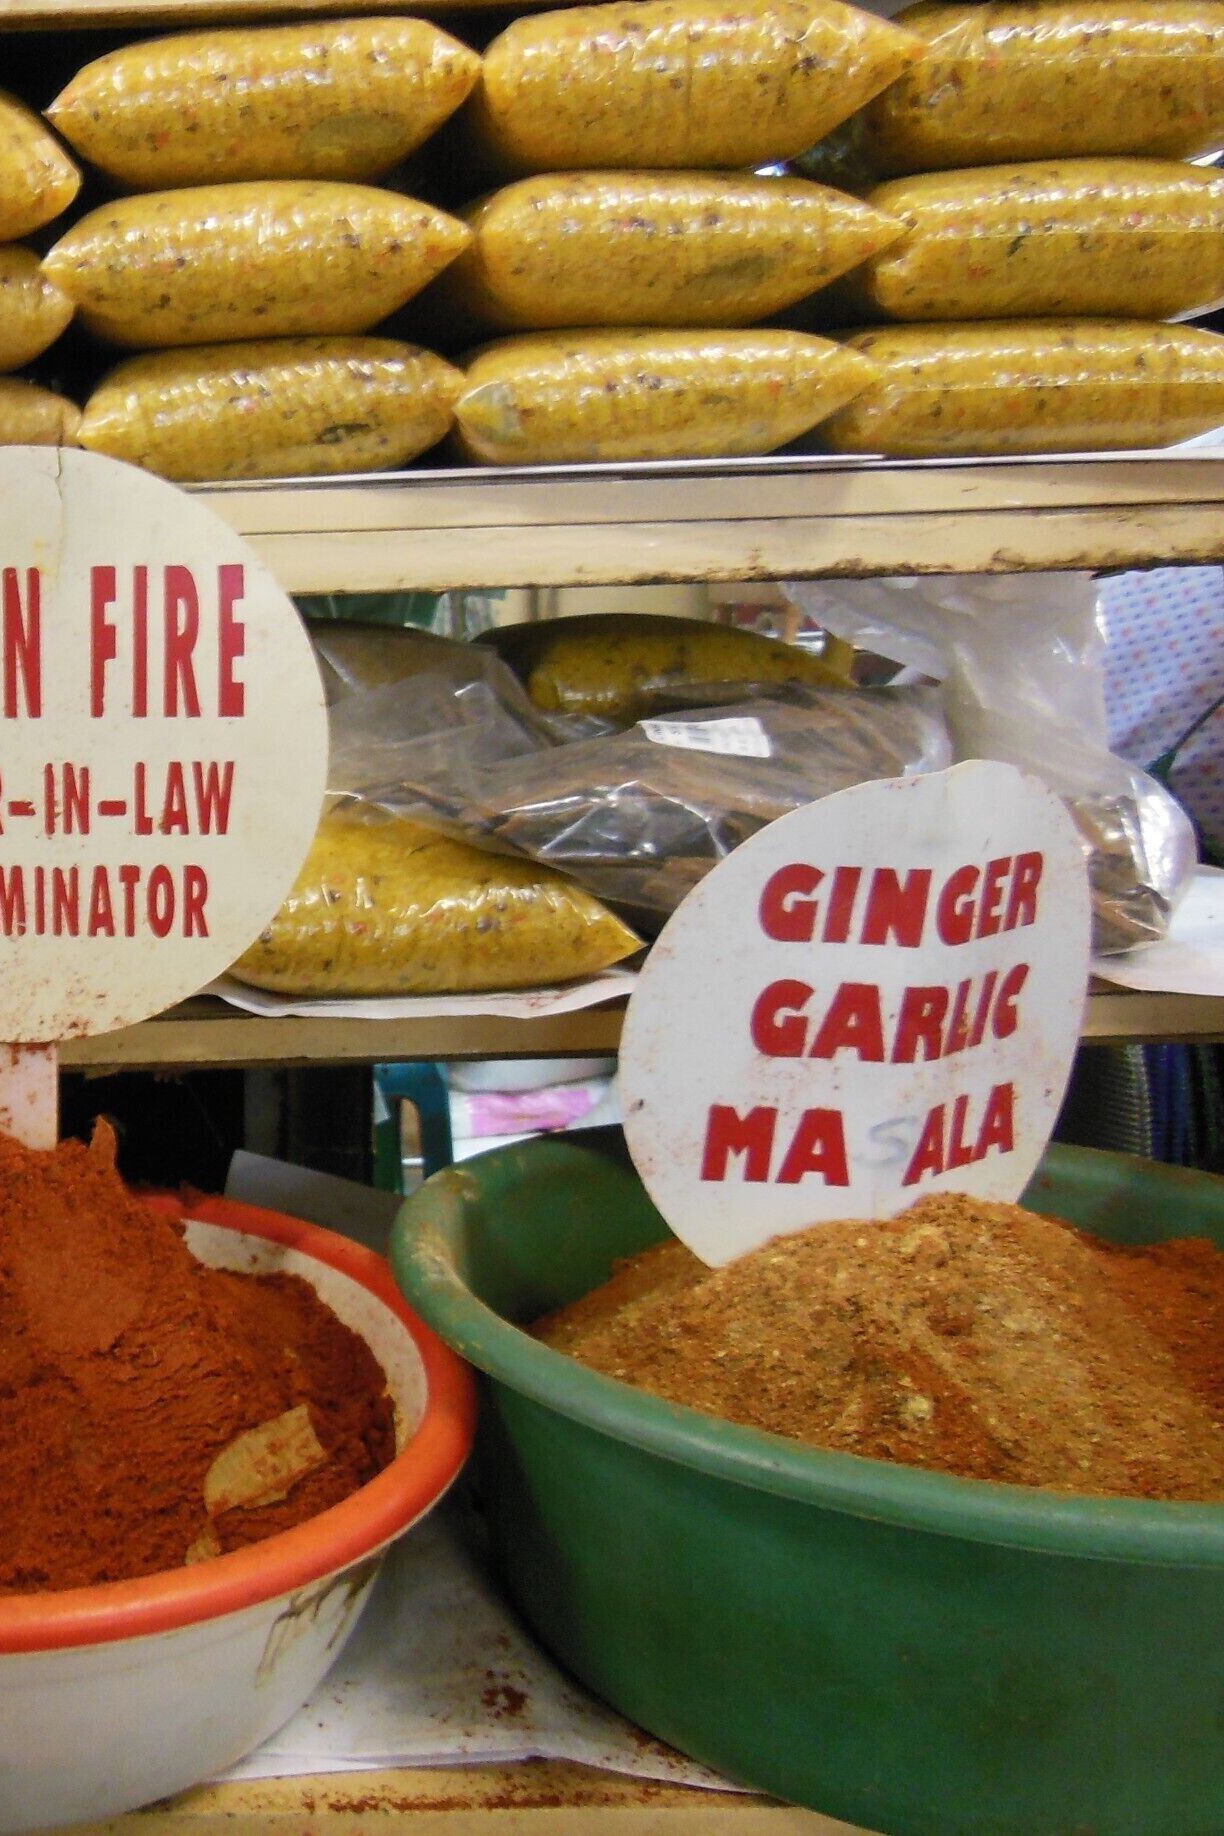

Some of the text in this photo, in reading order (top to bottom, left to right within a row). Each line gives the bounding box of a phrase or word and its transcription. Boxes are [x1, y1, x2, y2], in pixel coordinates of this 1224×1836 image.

[89, 563, 245, 719] FIRE
[757, 850, 1045, 949] GINGER
[749, 961, 1030, 1064] GARLIC
